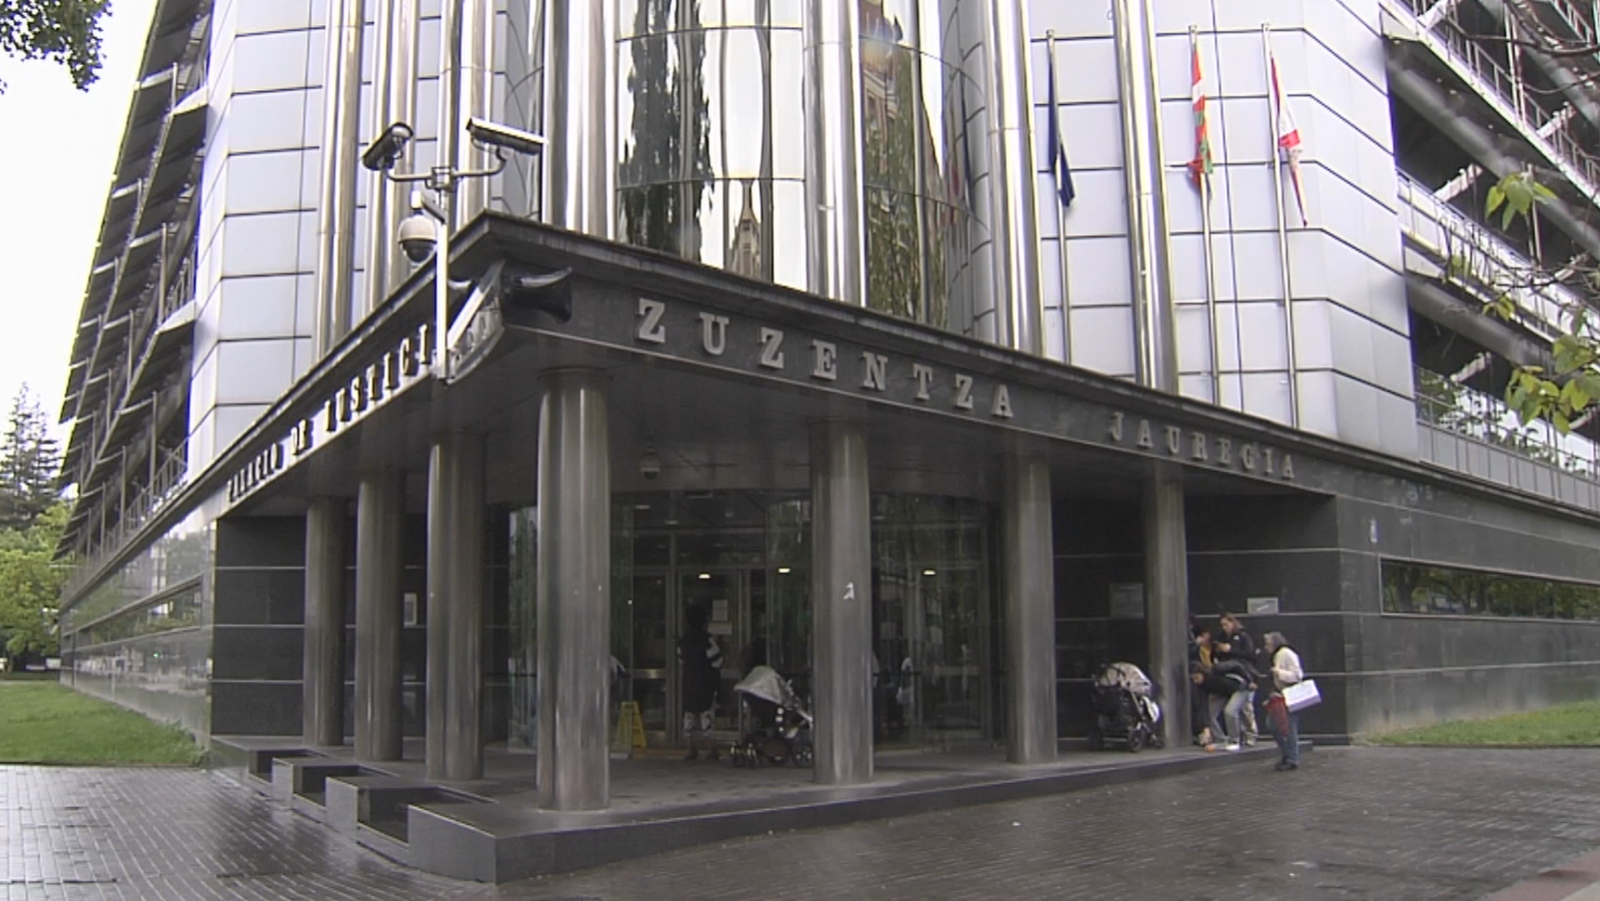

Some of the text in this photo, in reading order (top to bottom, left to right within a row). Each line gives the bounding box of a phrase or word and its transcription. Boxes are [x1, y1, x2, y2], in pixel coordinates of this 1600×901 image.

[324, 323, 437, 433] JUSTICI
[638, 298, 1296, 479] ZUZENTZA JAUREGIA
